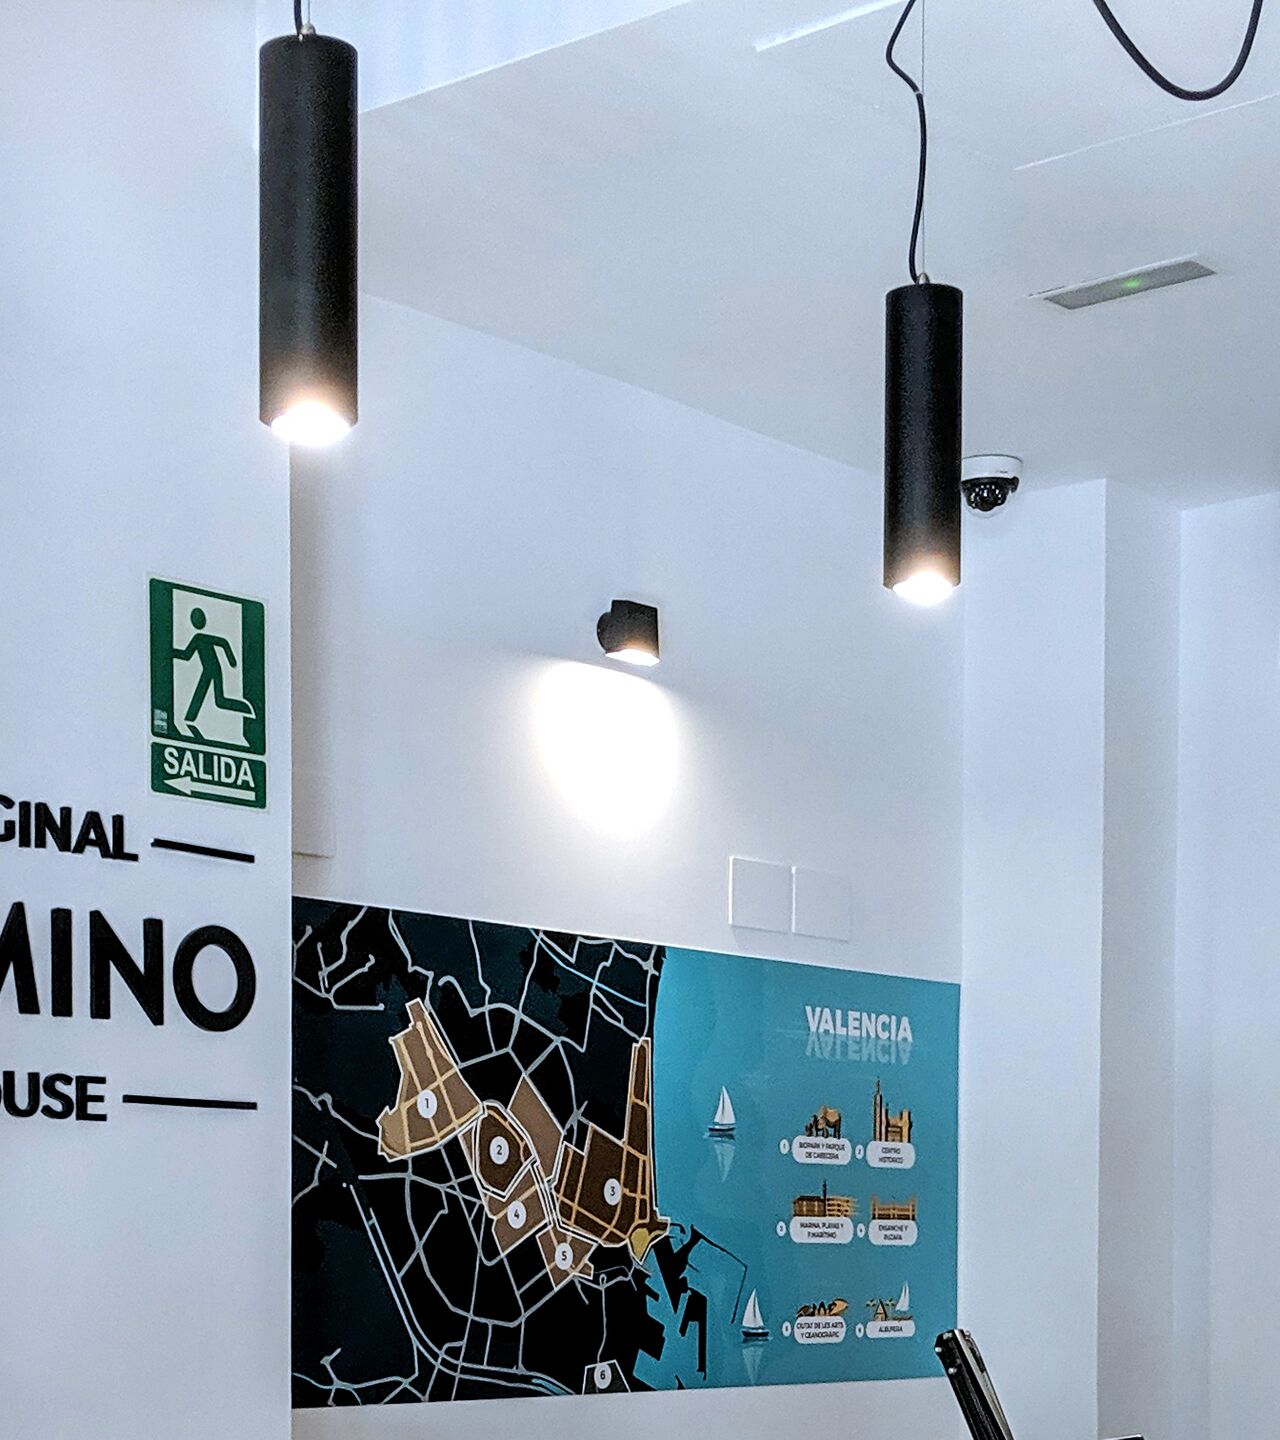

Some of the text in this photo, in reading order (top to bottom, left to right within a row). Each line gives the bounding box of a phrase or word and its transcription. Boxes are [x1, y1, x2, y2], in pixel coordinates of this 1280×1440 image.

[164, 747, 255, 788] SALIDA
[805, 1006, 913, 1042] VALENCIA
[496, 1145, 502, 1156] 2
[610, 1186, 615, 1196] 3
[514, 1209, 520, 1219] 4
[561, 1251, 567, 1261] 5
[600, 1370, 606, 1380] 6
